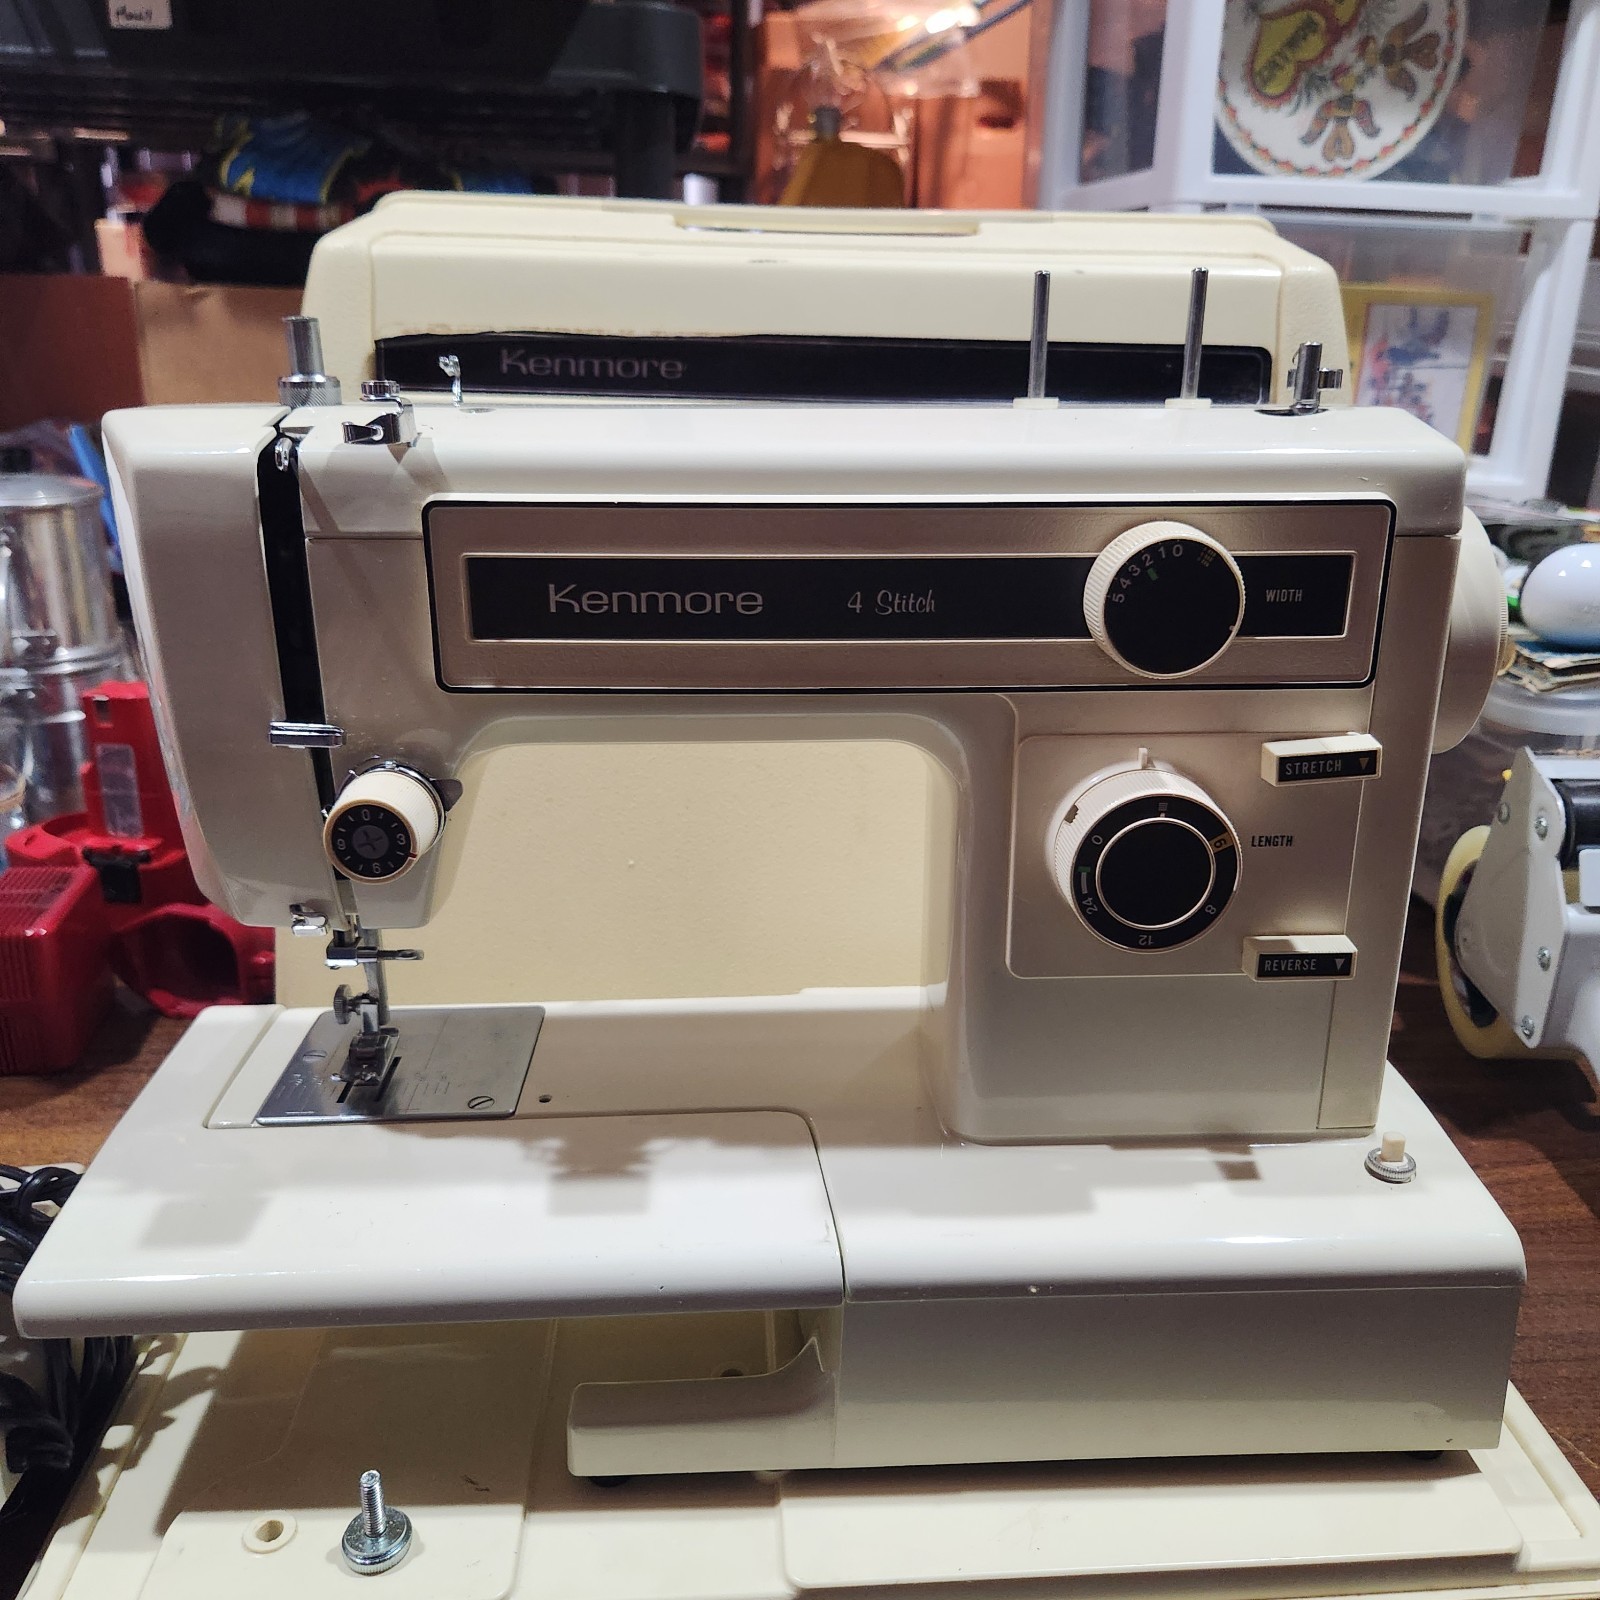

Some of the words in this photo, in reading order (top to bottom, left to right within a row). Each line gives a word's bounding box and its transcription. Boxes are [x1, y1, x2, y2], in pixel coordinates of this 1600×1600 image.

[501, 348, 684, 379] Kenmore
[1112, 593, 1125, 604] 5
[1120, 578, 1132, 589] 4
[1128, 564, 1141, 577] 3
[1141, 553, 1155, 567] 2
[1158, 546, 1166, 559] 1
[1172, 544, 1184, 557] 0
[548, 583, 764, 615] Kenmore
[847, 591, 863, 614] 4
[874, 589, 936, 616] Stitch
[1265, 589, 1303, 603] WIDTH
[1285, 759, 1342, 776] STRETCH
[361, 808, 371, 821] 0
[337, 838, 347, 850] 9
[396, 833, 406, 845] 3
[1091, 834, 1103, 846] 0
[1251, 835, 1293, 848] LENGTH
[1081, 896, 1099, 916] 24
[1204, 904, 1217, 915] 8
[1138, 934, 1154, 946] 12
[1264, 958, 1317, 972] REVERSE
